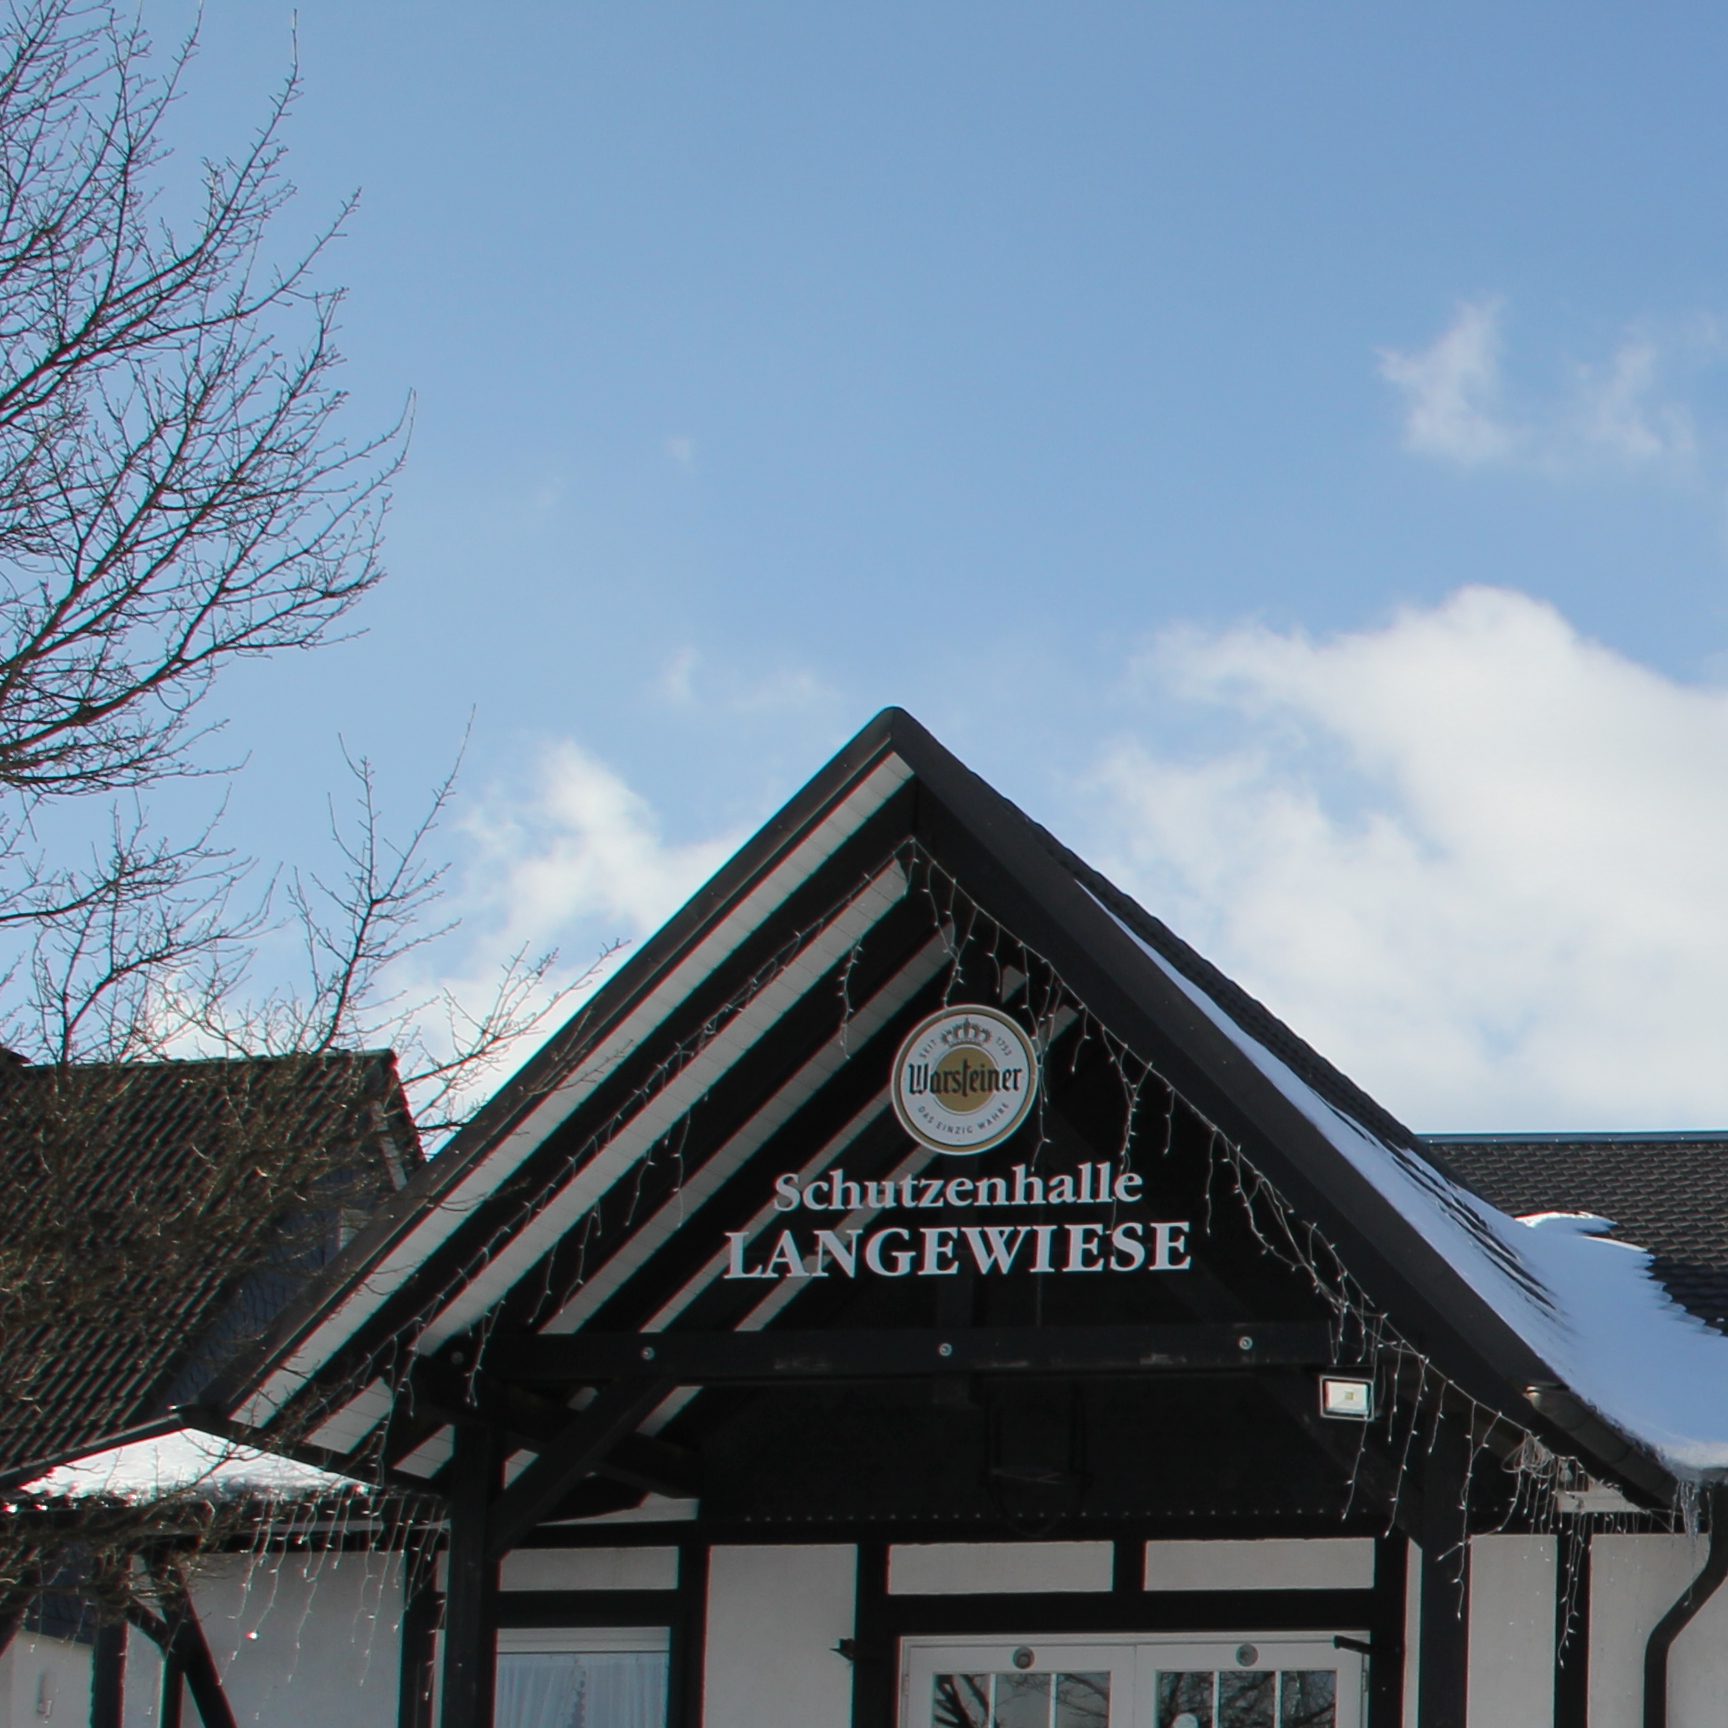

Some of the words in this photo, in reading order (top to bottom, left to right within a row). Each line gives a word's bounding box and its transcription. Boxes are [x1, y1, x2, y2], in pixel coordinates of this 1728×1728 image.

[919, 1039, 938, 1059] SEIT
[995, 1036, 1013, 1057] 1753
[908, 1058, 1023, 1098] Warsteiner
[917, 1106, 935, 1124] DAS
[936, 1121, 974, 1135] EINZIG
[977, 1103, 1010, 1130] WAHRE
[723, 1221, 1192, 1280] LANGEWIESE
